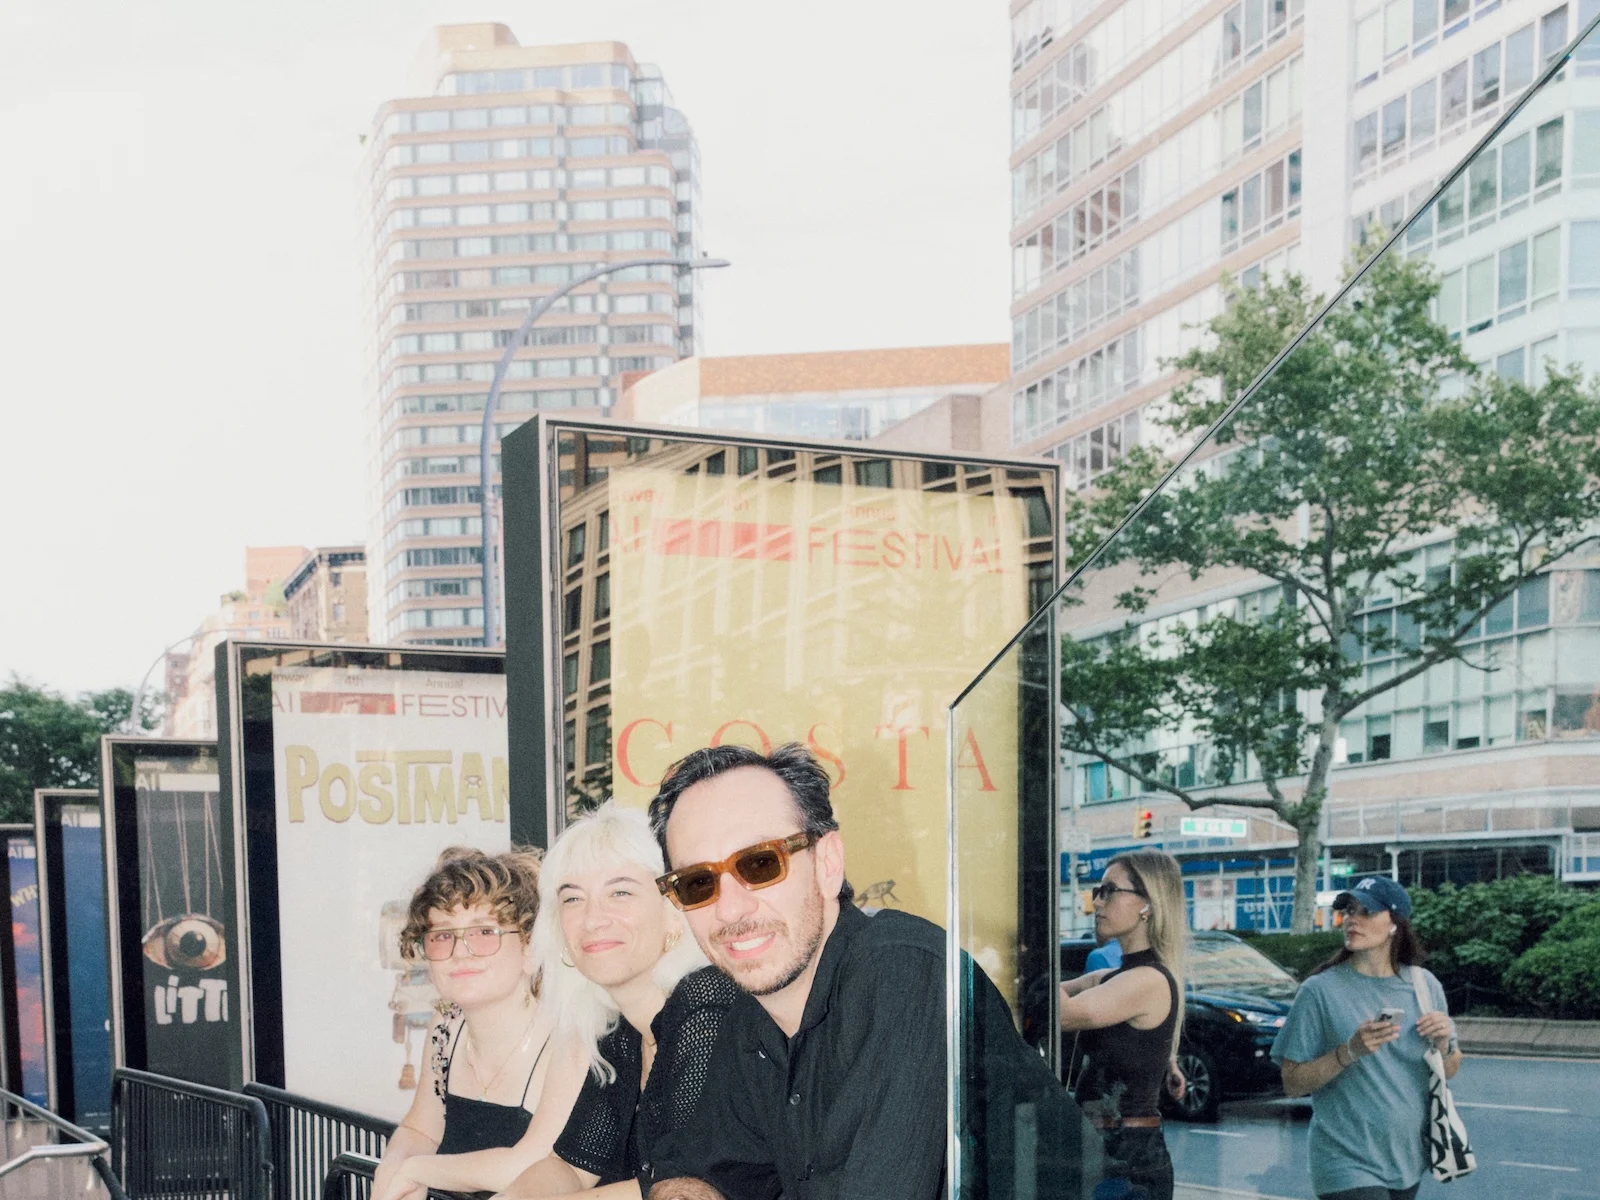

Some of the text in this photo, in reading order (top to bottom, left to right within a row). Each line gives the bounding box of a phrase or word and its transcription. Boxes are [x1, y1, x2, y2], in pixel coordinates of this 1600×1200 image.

[807, 526, 1017, 575] FESTIVAL
[272, 691, 294, 714] AI
[135, 772, 157, 792] AI
